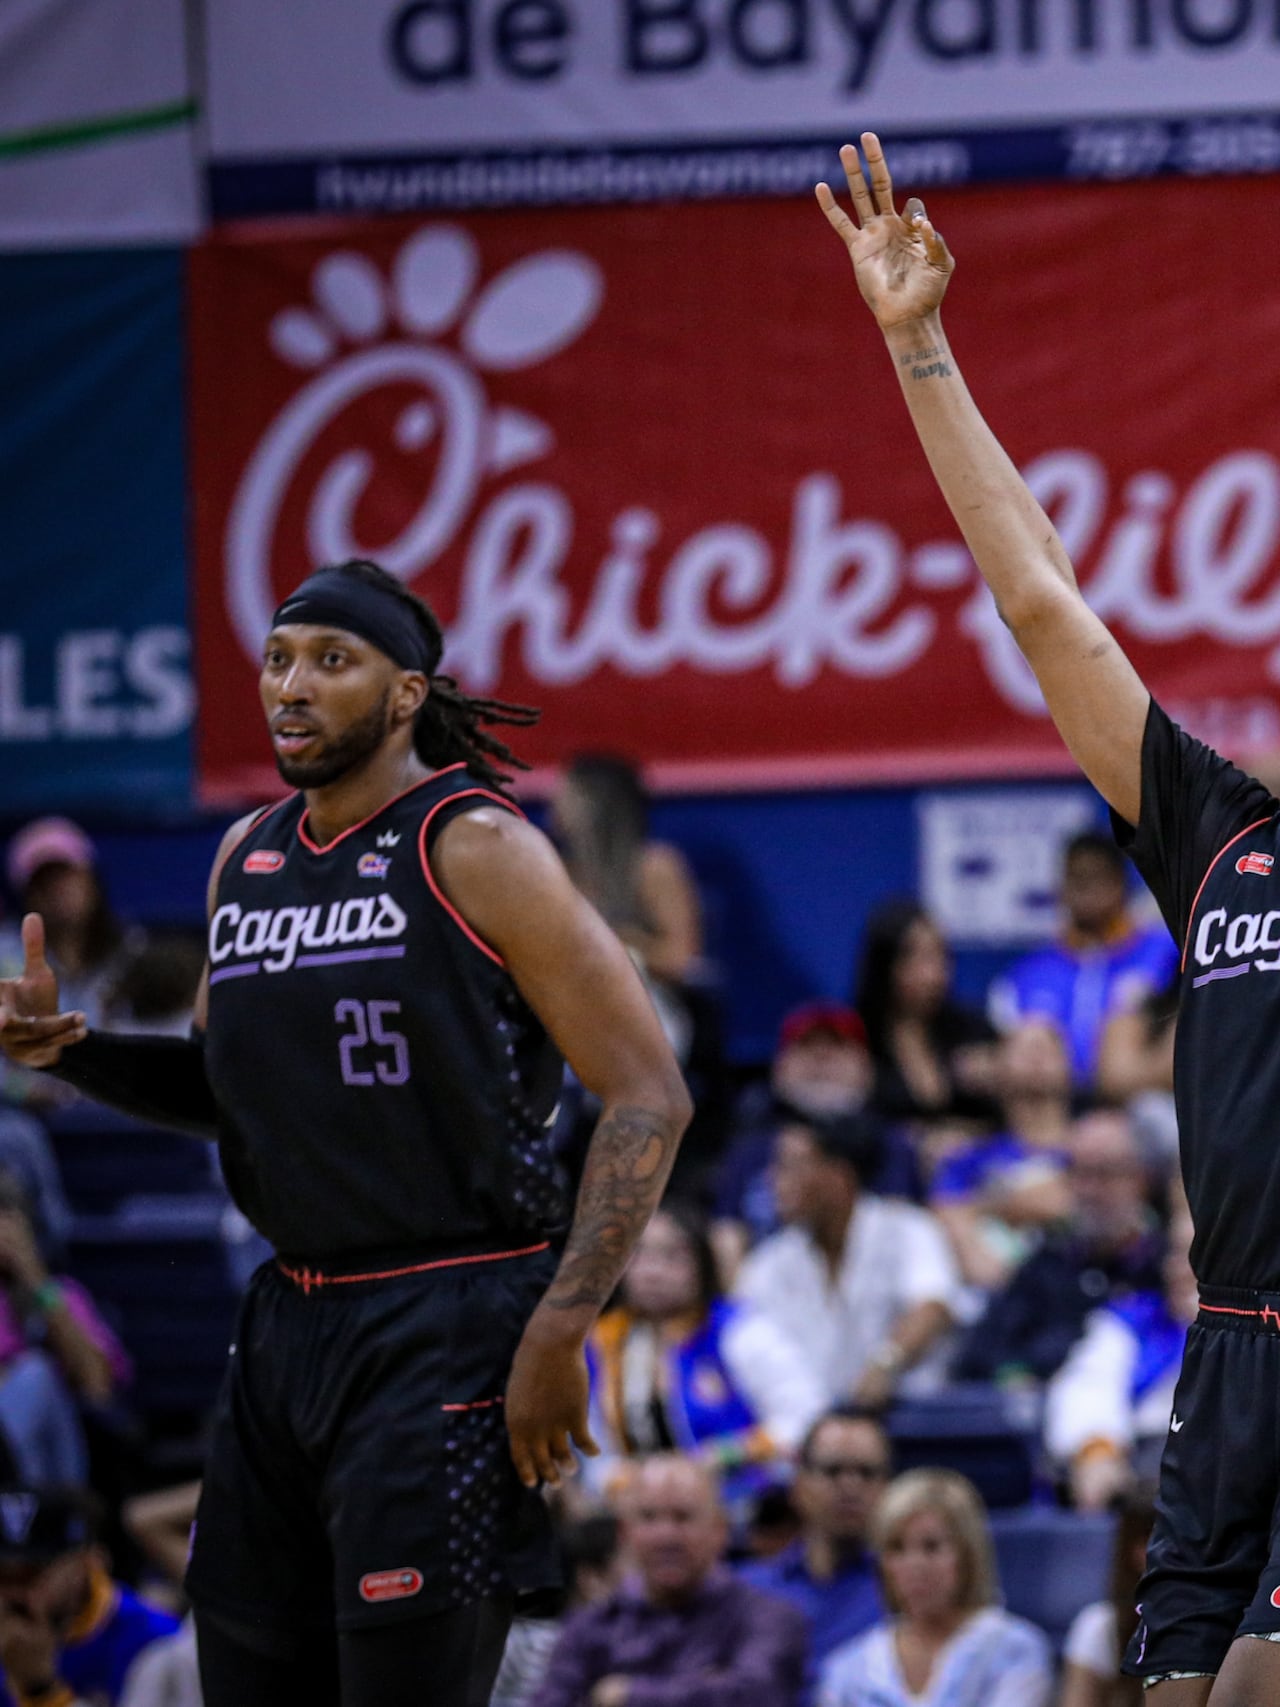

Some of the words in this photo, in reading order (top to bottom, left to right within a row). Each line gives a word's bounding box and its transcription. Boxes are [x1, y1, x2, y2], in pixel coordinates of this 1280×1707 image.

[388, 0, 570, 86] de
[208, 893, 408, 974] Caguas
[333, 998, 411, 1087] 25
